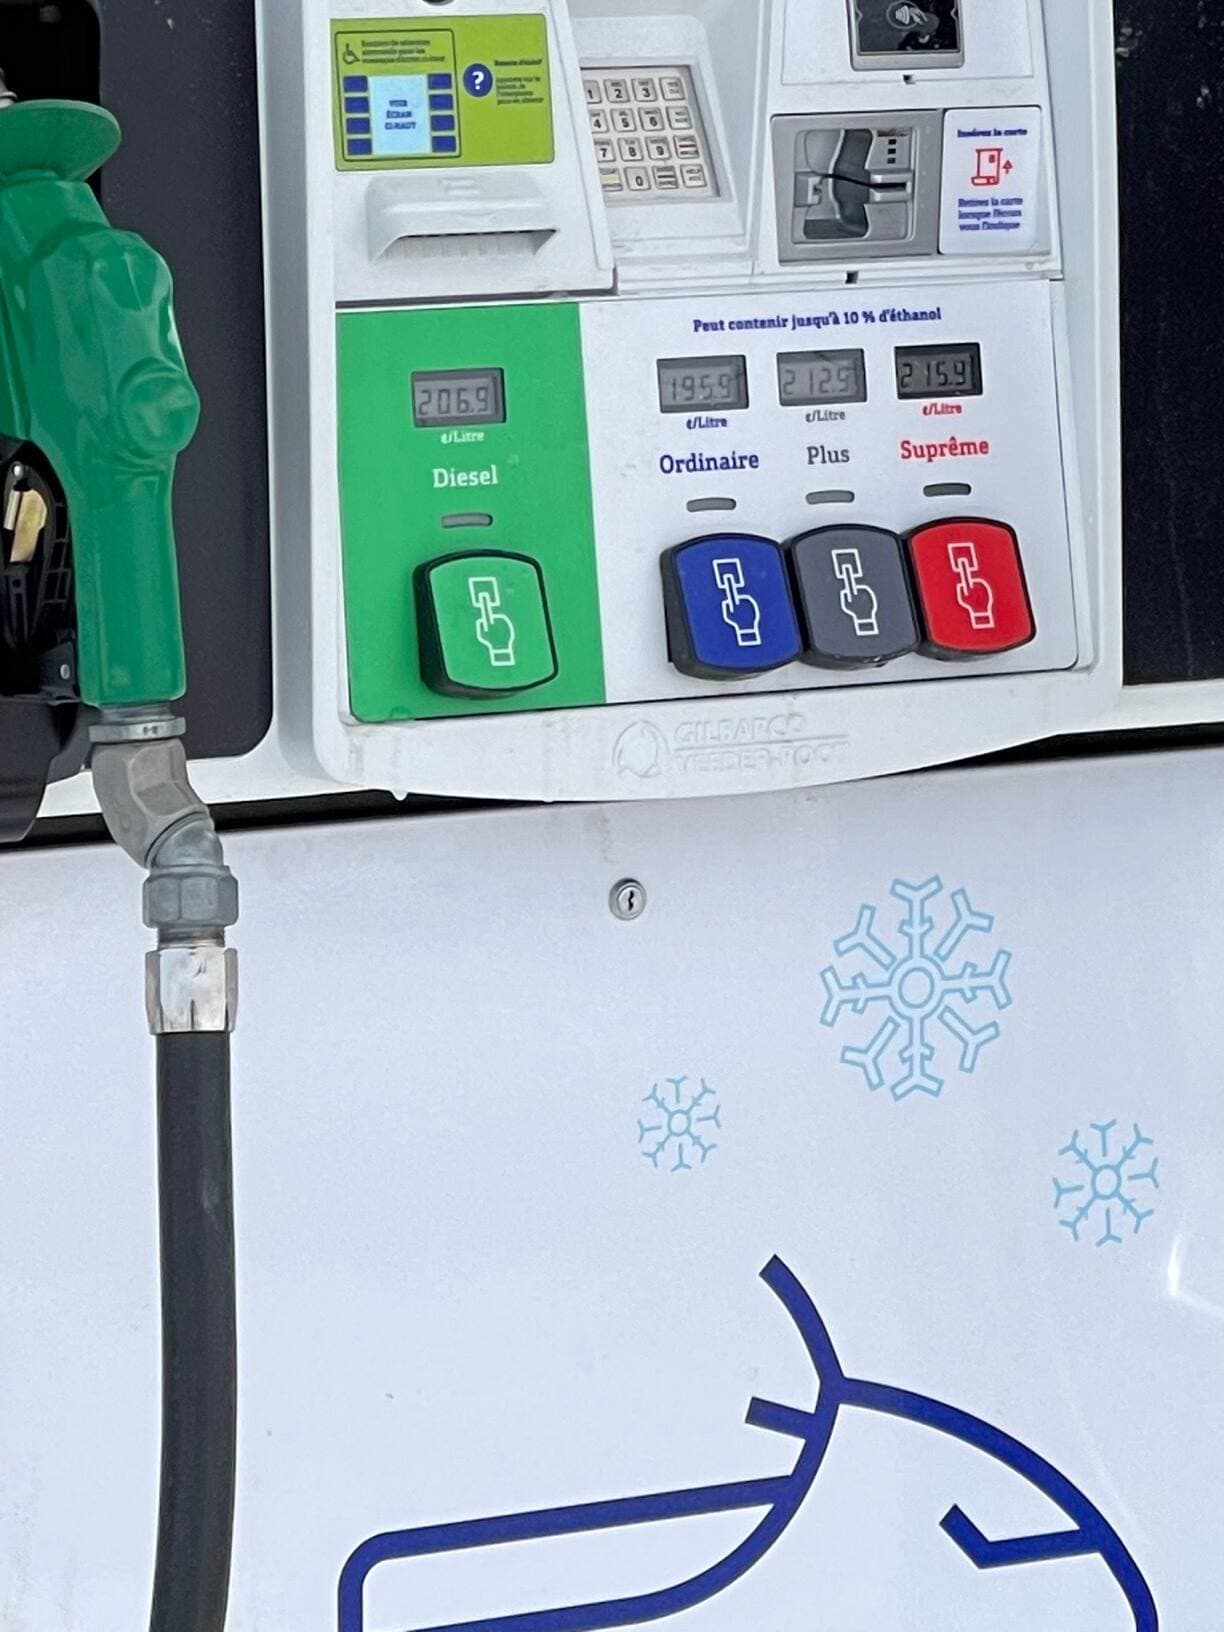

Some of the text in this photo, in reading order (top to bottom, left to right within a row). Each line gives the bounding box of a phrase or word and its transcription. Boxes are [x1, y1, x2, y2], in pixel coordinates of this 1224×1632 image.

[693, 307, 942, 332] Peut contenir jusqu'à 10 % d'éthanol
[805, 409, 845, 423] ¢/Litre
[922, 402, 962, 416] ¢/Litre
[686, 416, 727, 430] ¢/Litre
[807, 445, 850, 465] Plus
[900, 436, 990, 463] Suprême
[659, 450, 759, 474] Ordinaire
[432, 464, 498, 488] Diesel
